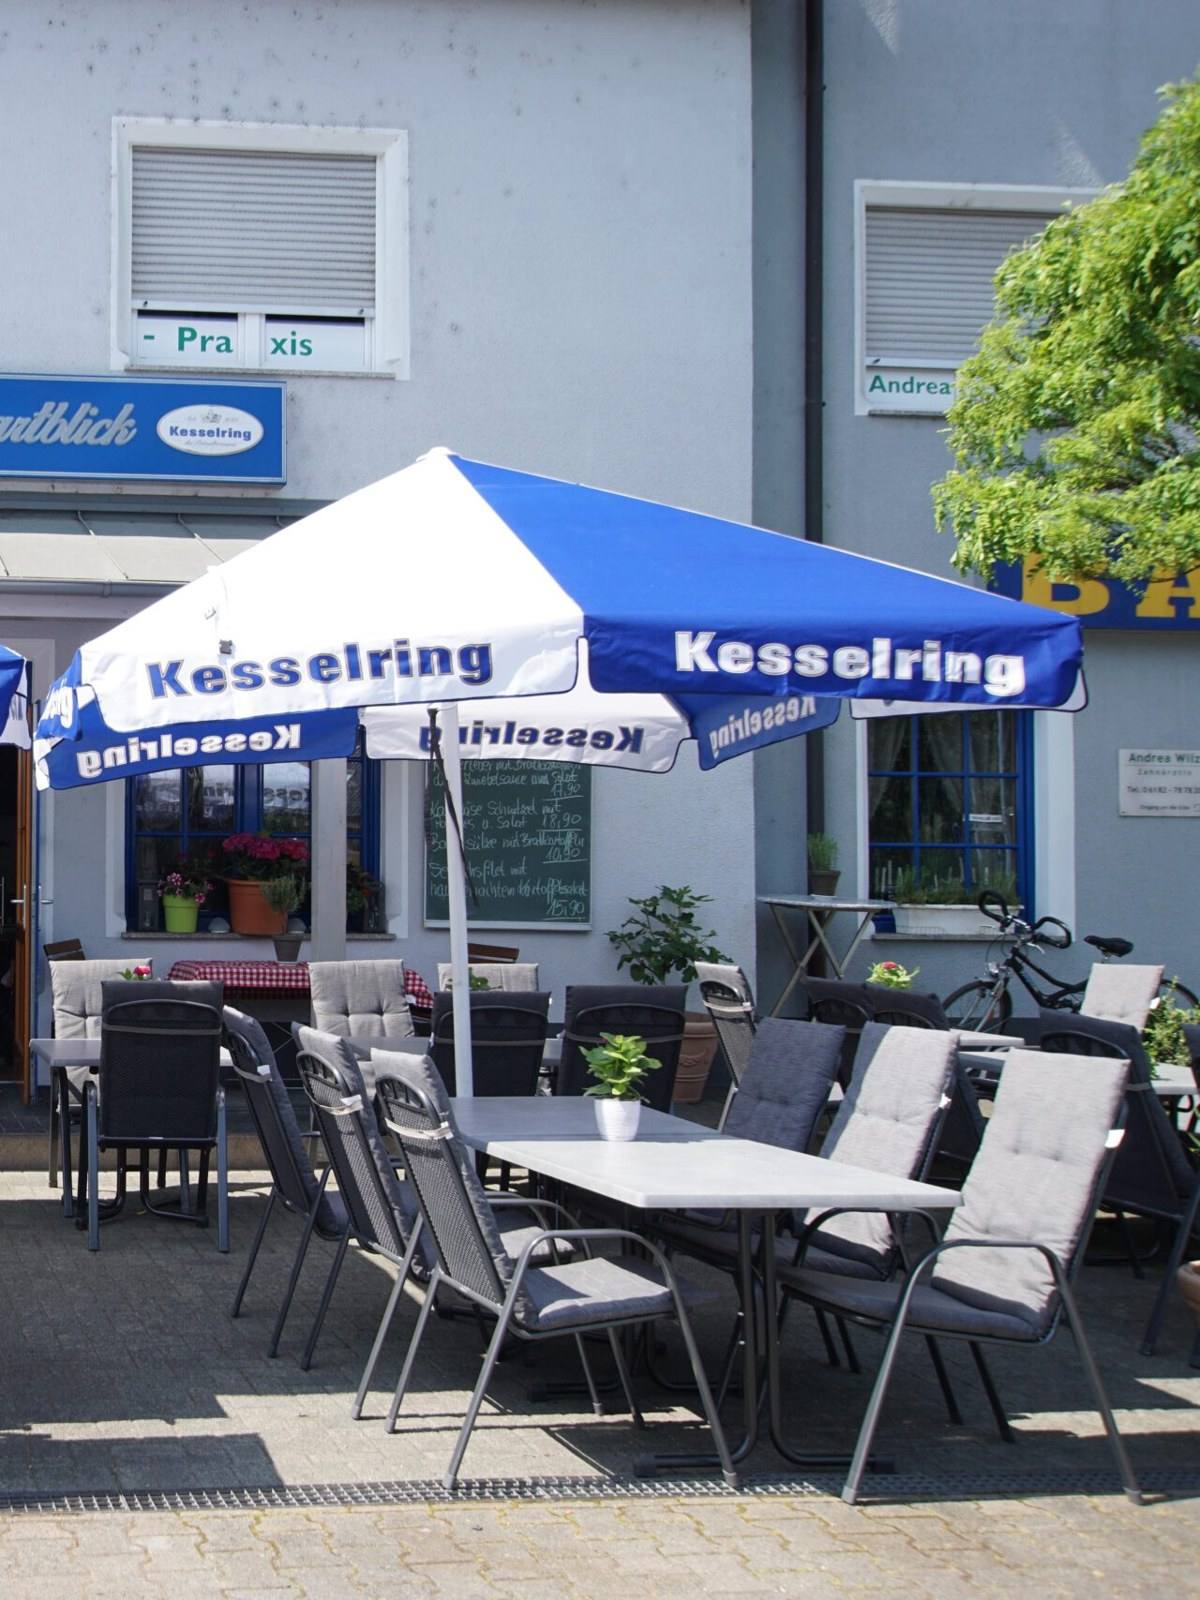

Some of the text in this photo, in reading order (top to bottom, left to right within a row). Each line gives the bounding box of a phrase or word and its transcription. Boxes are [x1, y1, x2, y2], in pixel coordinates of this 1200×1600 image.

[177, 326, 234, 353] Pra
[270, 331, 313, 356] xis
[868, 375, 952, 395] Andrea
[169, 425, 252, 441] Kesselring
[145, 638, 493, 698] Kesselring
[675, 630, 1025, 698] Kesselring
